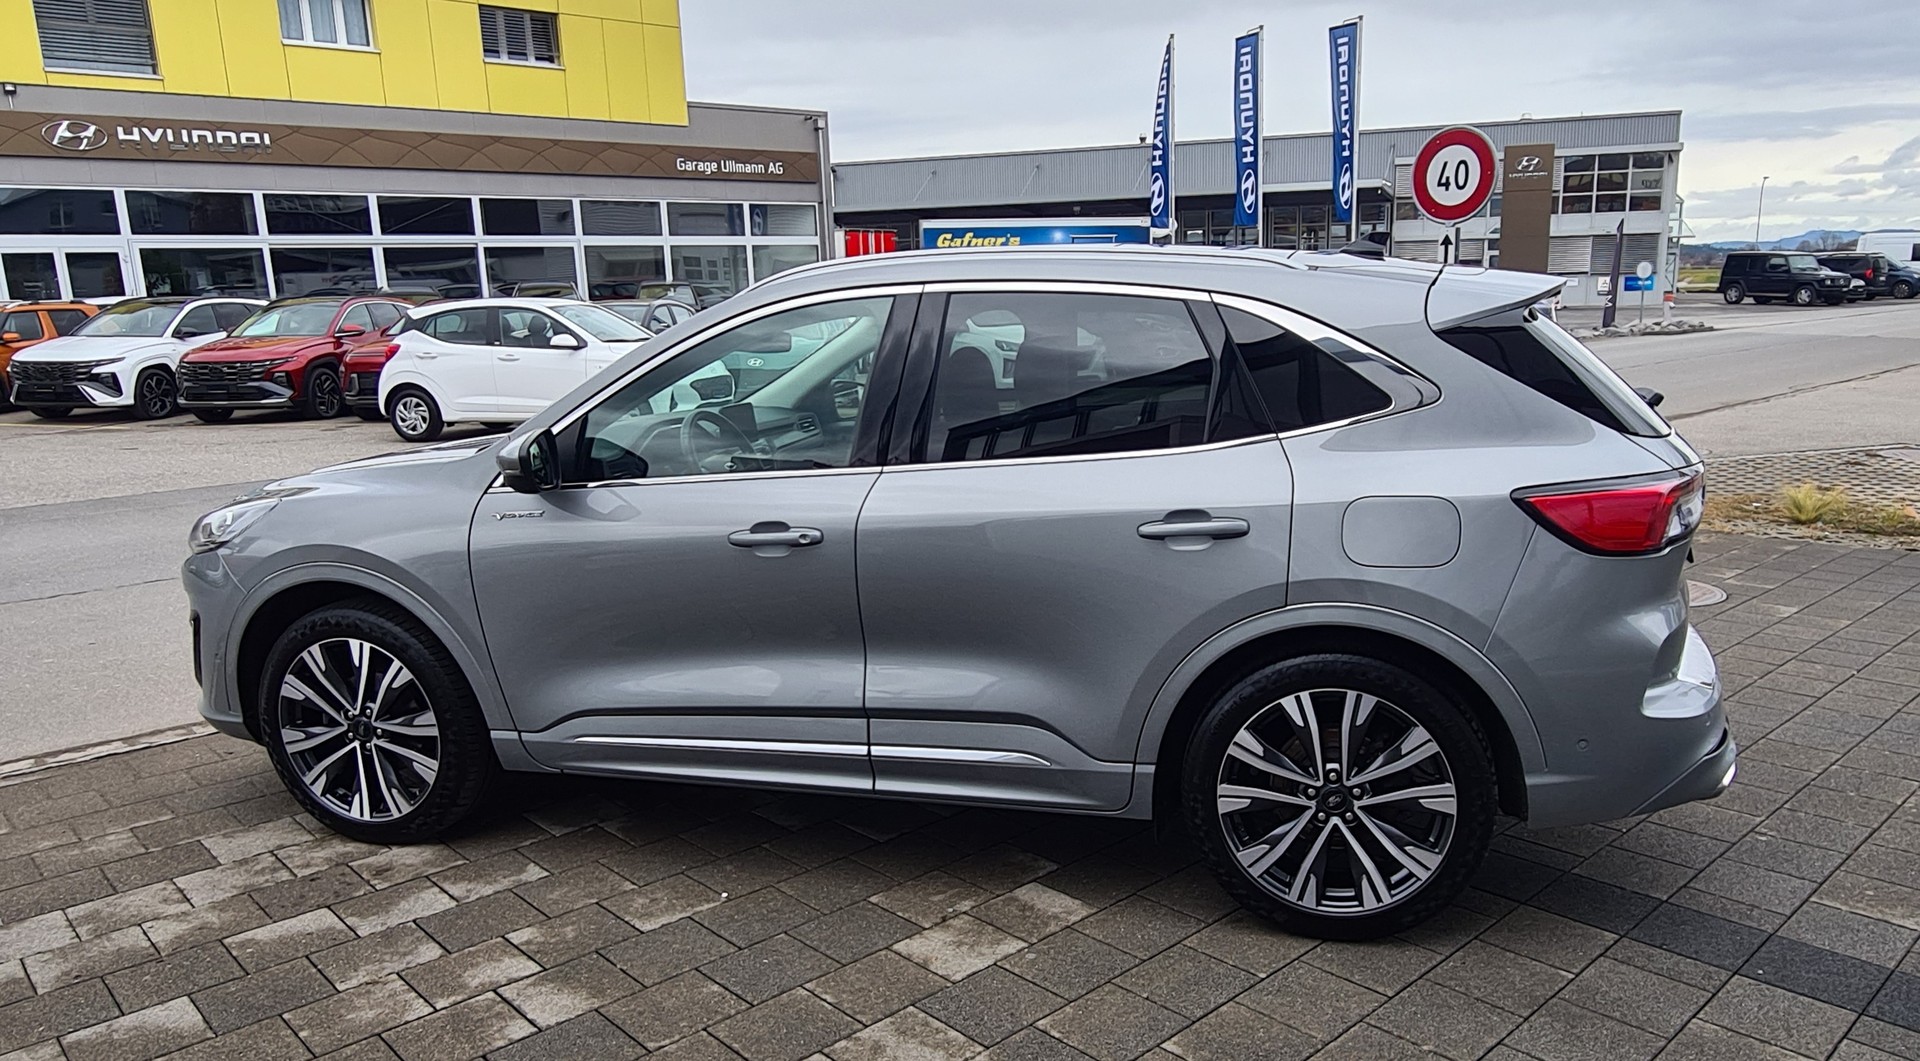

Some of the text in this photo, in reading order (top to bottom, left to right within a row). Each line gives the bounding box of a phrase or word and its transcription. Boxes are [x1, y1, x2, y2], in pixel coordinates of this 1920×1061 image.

[116, 125, 272, 153] HYUNDAI
[676, 158, 784, 175] Garage Ullmann AG
[1437, 159, 1469, 192] 40
[936, 232, 1021, 248] Gafner's
